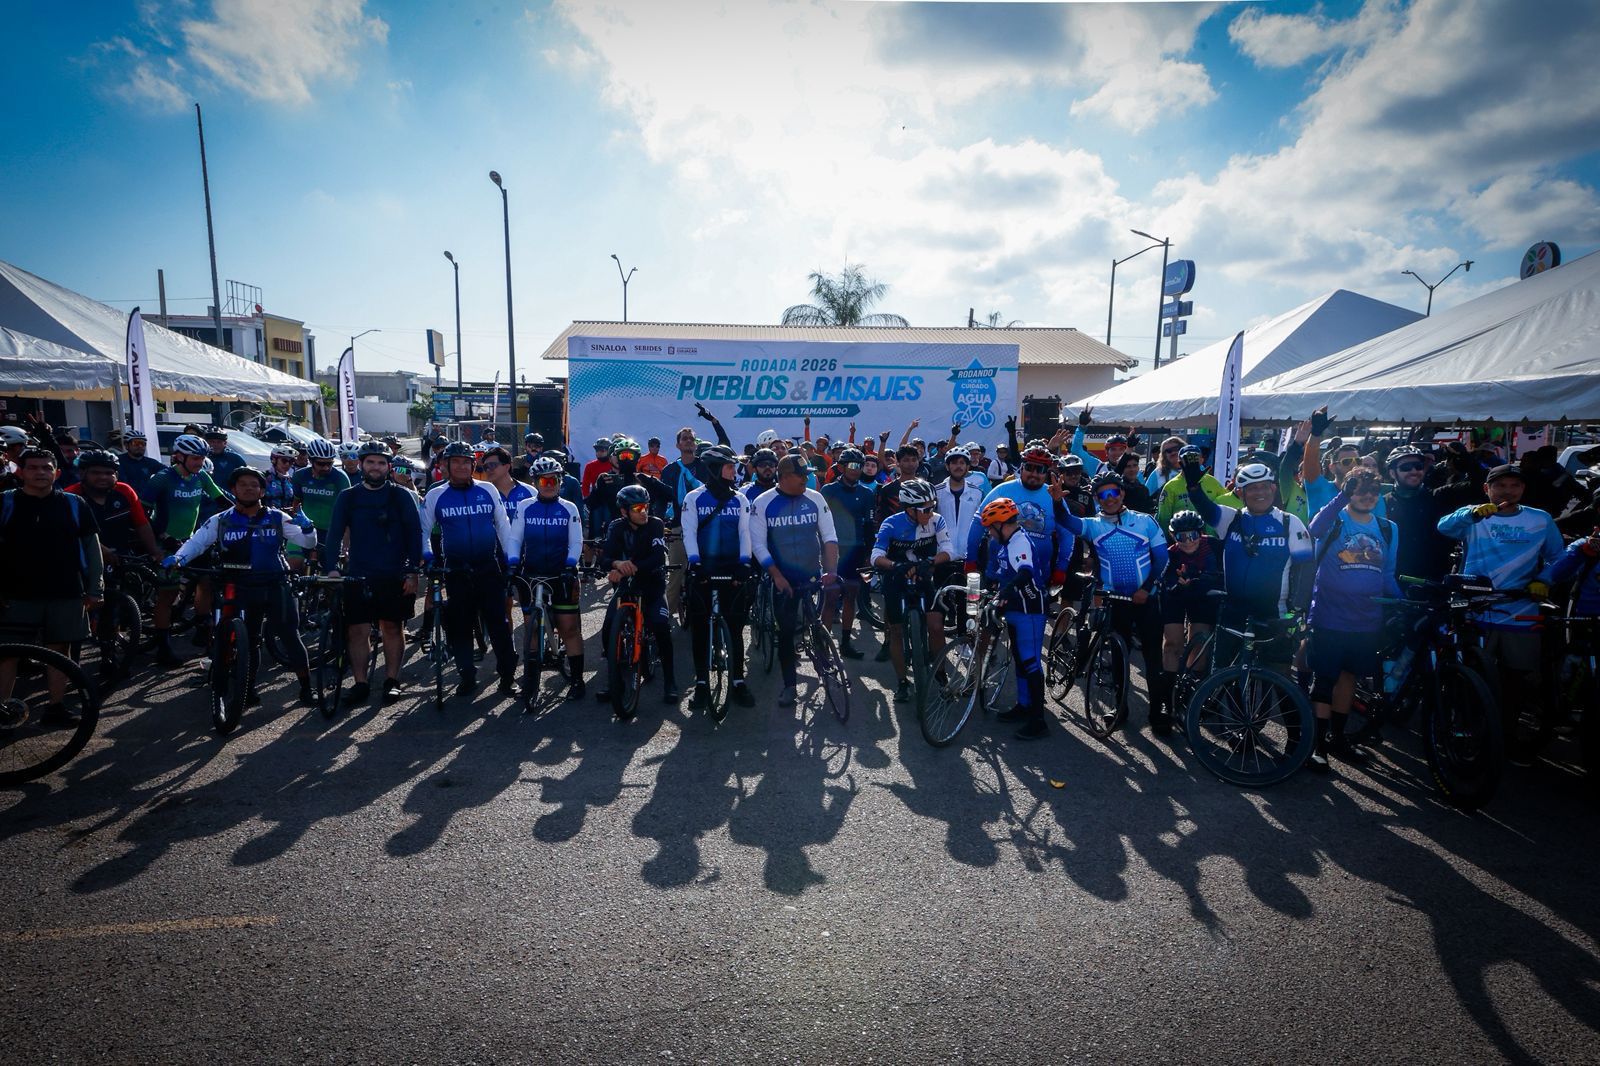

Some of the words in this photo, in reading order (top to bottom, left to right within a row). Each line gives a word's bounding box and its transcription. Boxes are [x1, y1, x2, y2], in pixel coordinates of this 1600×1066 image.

[591, 344, 627, 352] SINALOA
[741, 359, 798, 372] RODADA
[800, 359, 838, 372] 2026
[957, 369, 994, 379] RODANDO
[676, 375, 790, 401] PUEBLOS
[790, 380, 809, 401] &
[812, 375, 925, 401] PAISAJES
[957, 393, 992, 404] AGUA
[757, 408, 787, 416] RUMBO
[788, 408, 799, 416] AL
[800, 408, 848, 416] TAMARINDO
[441, 503, 493, 518] NAVOLATO
[526, 517, 569, 526] NAVOLATO
[767, 512, 818, 527] NAVOLATO
